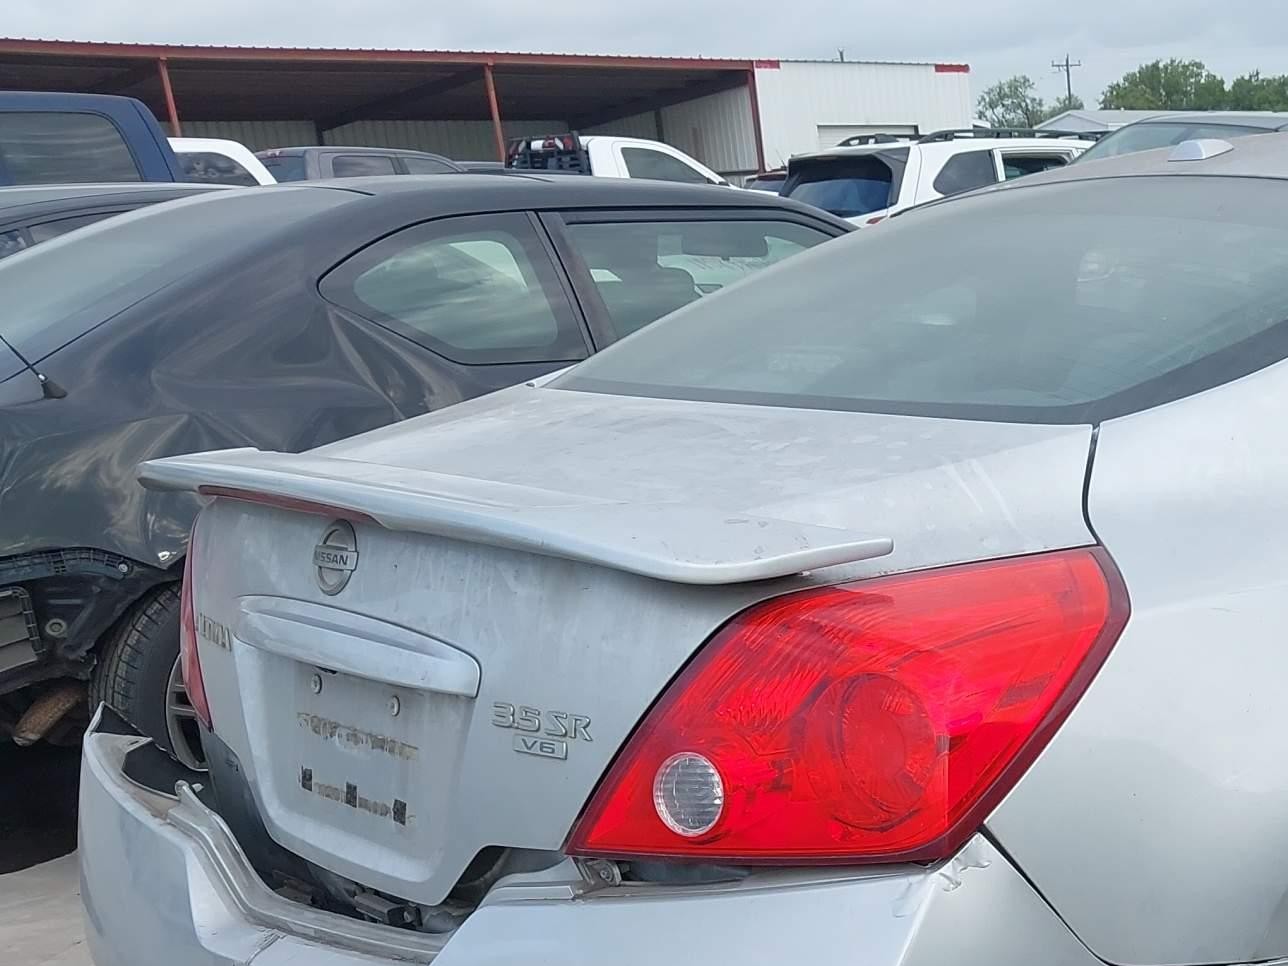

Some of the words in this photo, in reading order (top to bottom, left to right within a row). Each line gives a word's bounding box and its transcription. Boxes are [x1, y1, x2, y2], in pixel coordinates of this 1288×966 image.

[314, 549, 349, 566] NISSAN
[544, 710, 593, 742] SR
[521, 738, 556, 754] V6
